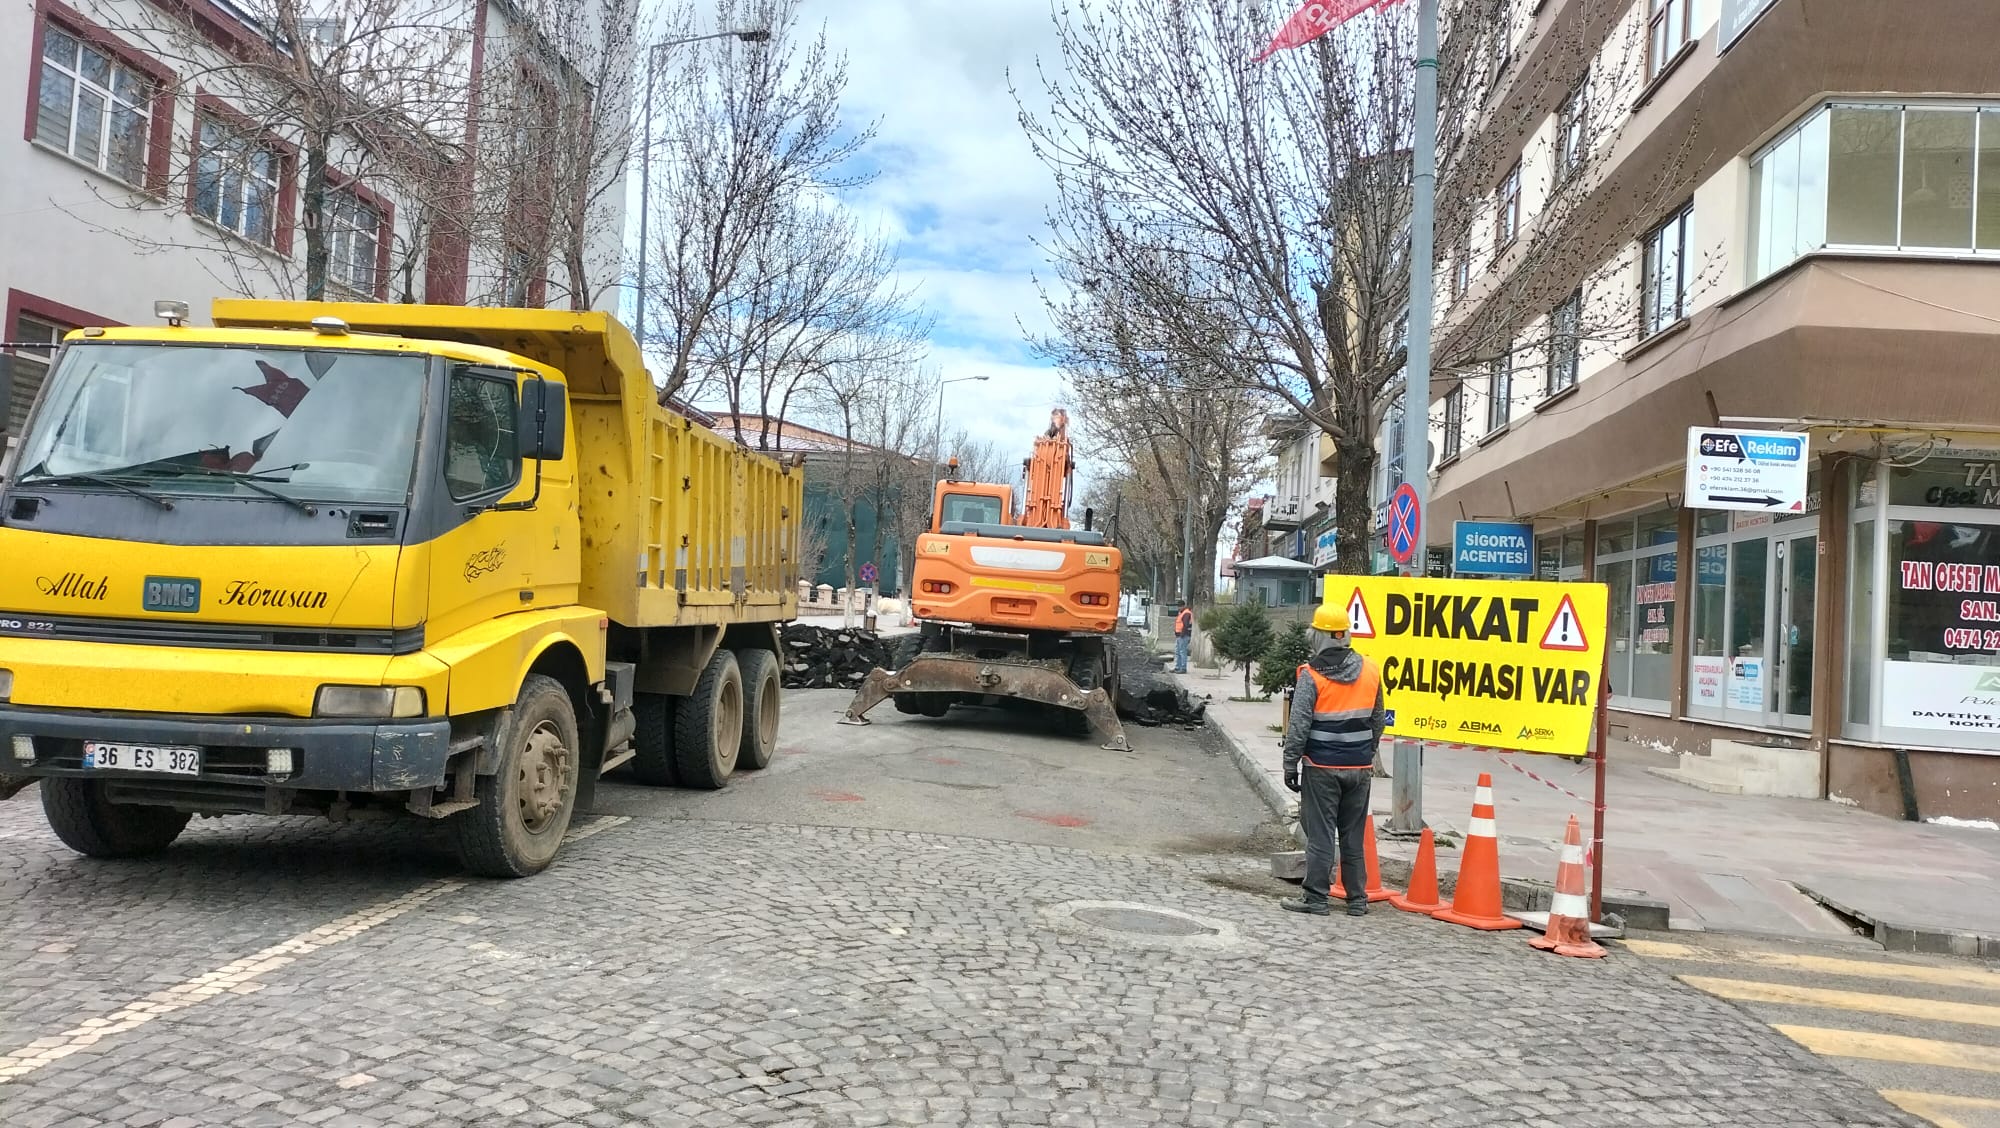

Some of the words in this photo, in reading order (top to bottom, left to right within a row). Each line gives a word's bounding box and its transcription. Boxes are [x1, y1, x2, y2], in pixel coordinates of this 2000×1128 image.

[1715, 439, 1738, 453] Efe
[1748, 440, 1796, 456] Reklam
[1465, 532, 1525, 548] SİGORTA
[1459, 549, 1528, 564] ACENTESİ
[36, 572, 108, 600] Allah
[1901, 561, 1933, 590] TAN
[1935, 562, 1982, 592] OFSET
[148, 582, 195, 607] BMC
[218, 580, 328, 608] Korusun
[1960, 599, 2000, 622] SAN.
[27, 621, 54, 631] 822
[1944, 627, 1982, 649] 0474
[1383, 656, 1523, 701] ÇALIŞMASI
[1532, 666, 1590, 706] VAR
[1414, 715, 1447, 730] eptisa
[1912, 710, 1992, 720] DAVETİYE
[1459, 720, 1503, 733] ABMA
[98, 747, 118, 765] 36
[135, 748, 154, 768] ES
[169, 751, 197, 771] 382
